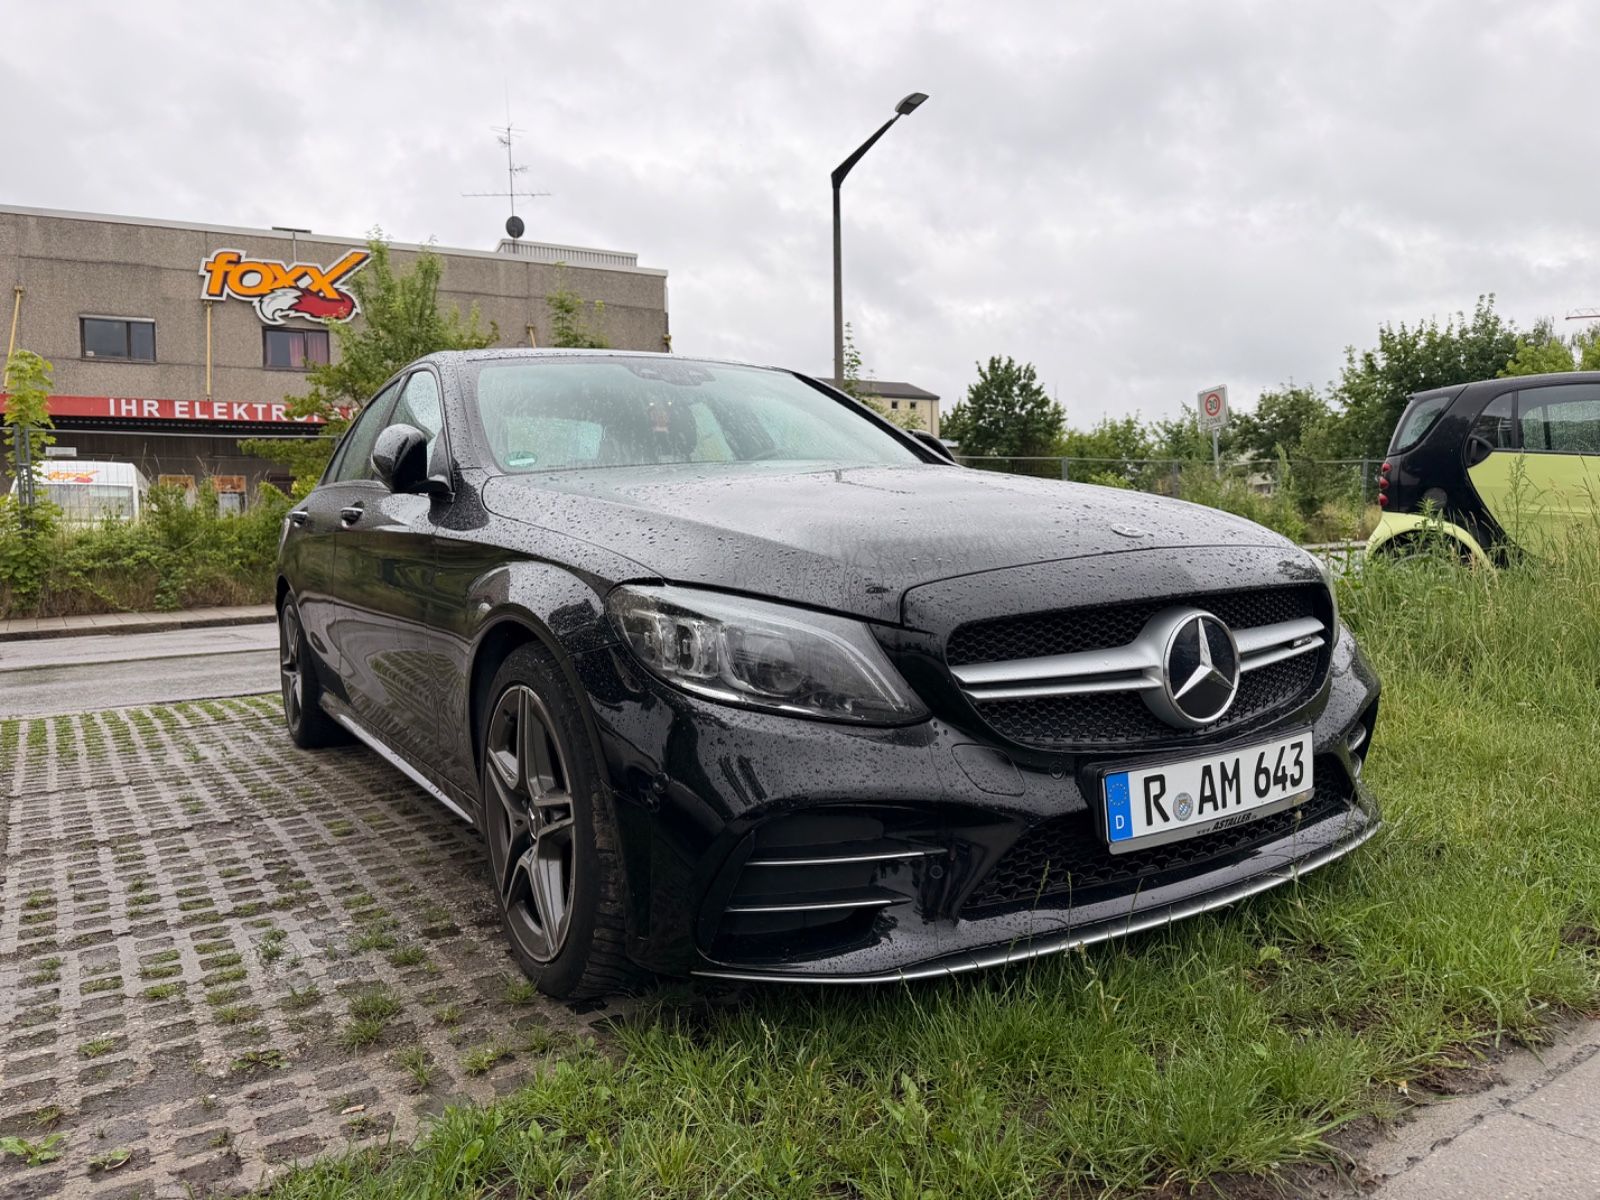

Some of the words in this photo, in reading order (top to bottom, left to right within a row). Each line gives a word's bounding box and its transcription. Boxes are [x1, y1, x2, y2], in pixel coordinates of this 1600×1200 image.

[203, 250, 371, 301] foxx
[109, 398, 160, 418] IHR
[1208, 398, 1218, 410] 30
[1143, 773, 1170, 826] R
[1198, 758, 1241, 815] AM
[1254, 741, 1304, 798] 643
[1115, 815, 1125, 830] D
